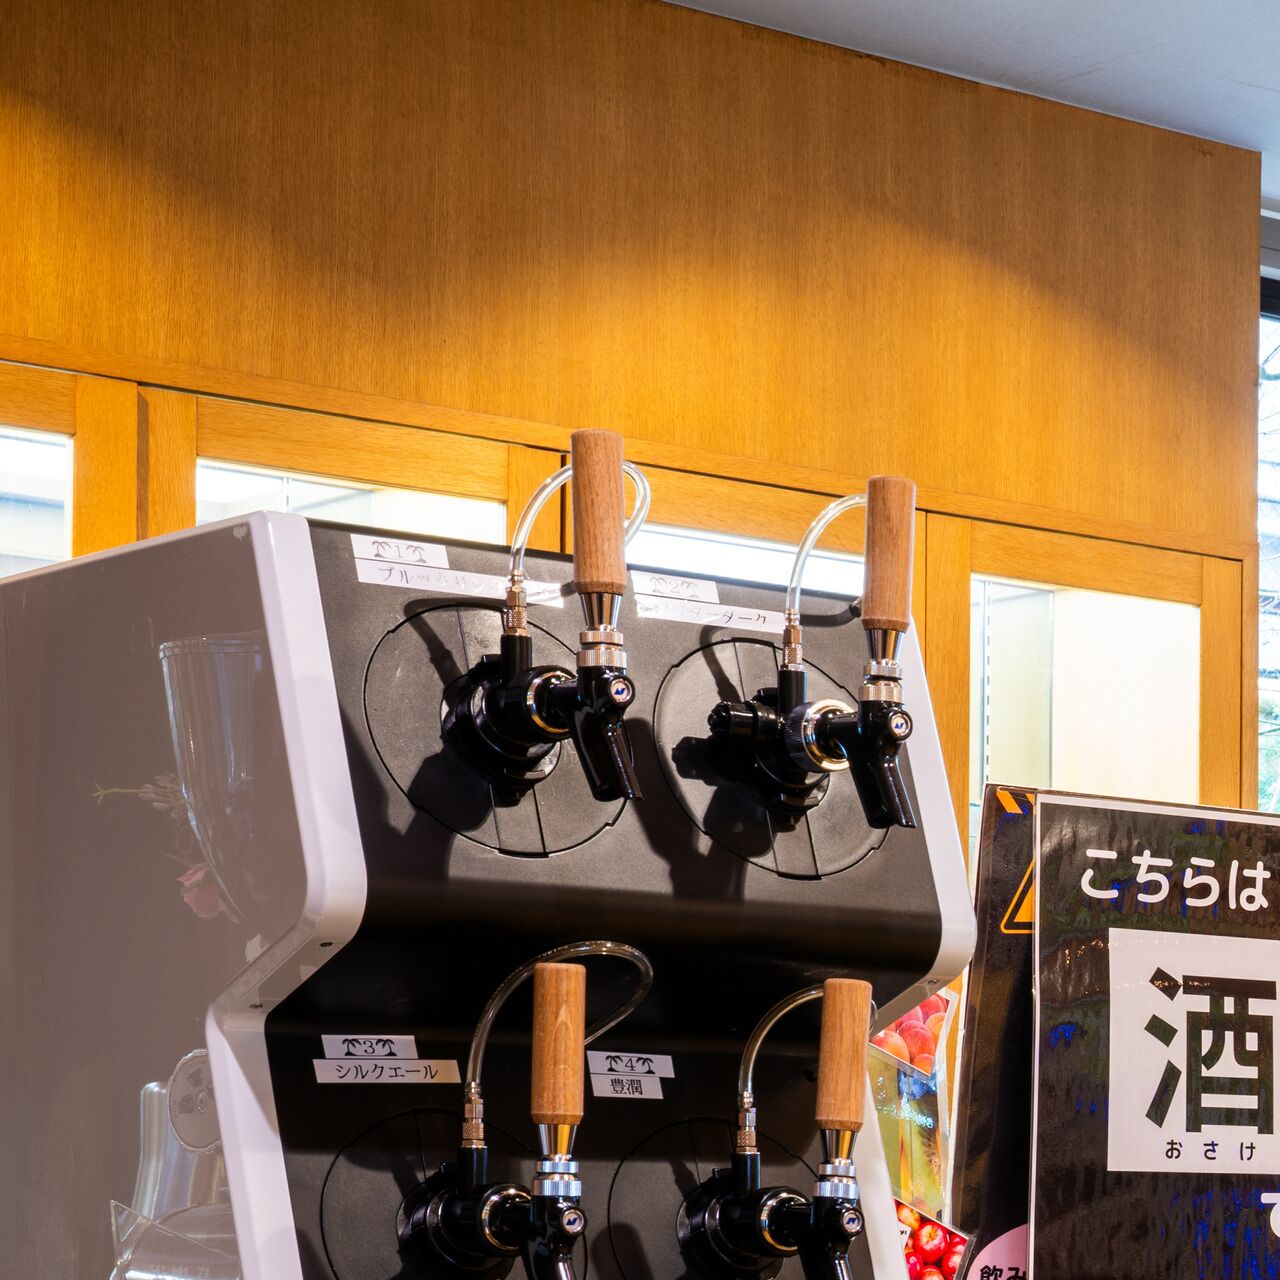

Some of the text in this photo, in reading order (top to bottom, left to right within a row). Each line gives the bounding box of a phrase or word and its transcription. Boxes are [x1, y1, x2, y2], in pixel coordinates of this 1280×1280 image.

[1080, 848, 1272, 912] こちらは
[363, 1039, 377, 1055] 3
[1143, 966, 1279, 1136] 酒
[334, 1063, 439, 1081] シルクエール
[624, 1058, 638, 1072] 4
[609, 1077, 643, 1096] 豊潤
[1165, 1138, 1257, 1162] おさけ
